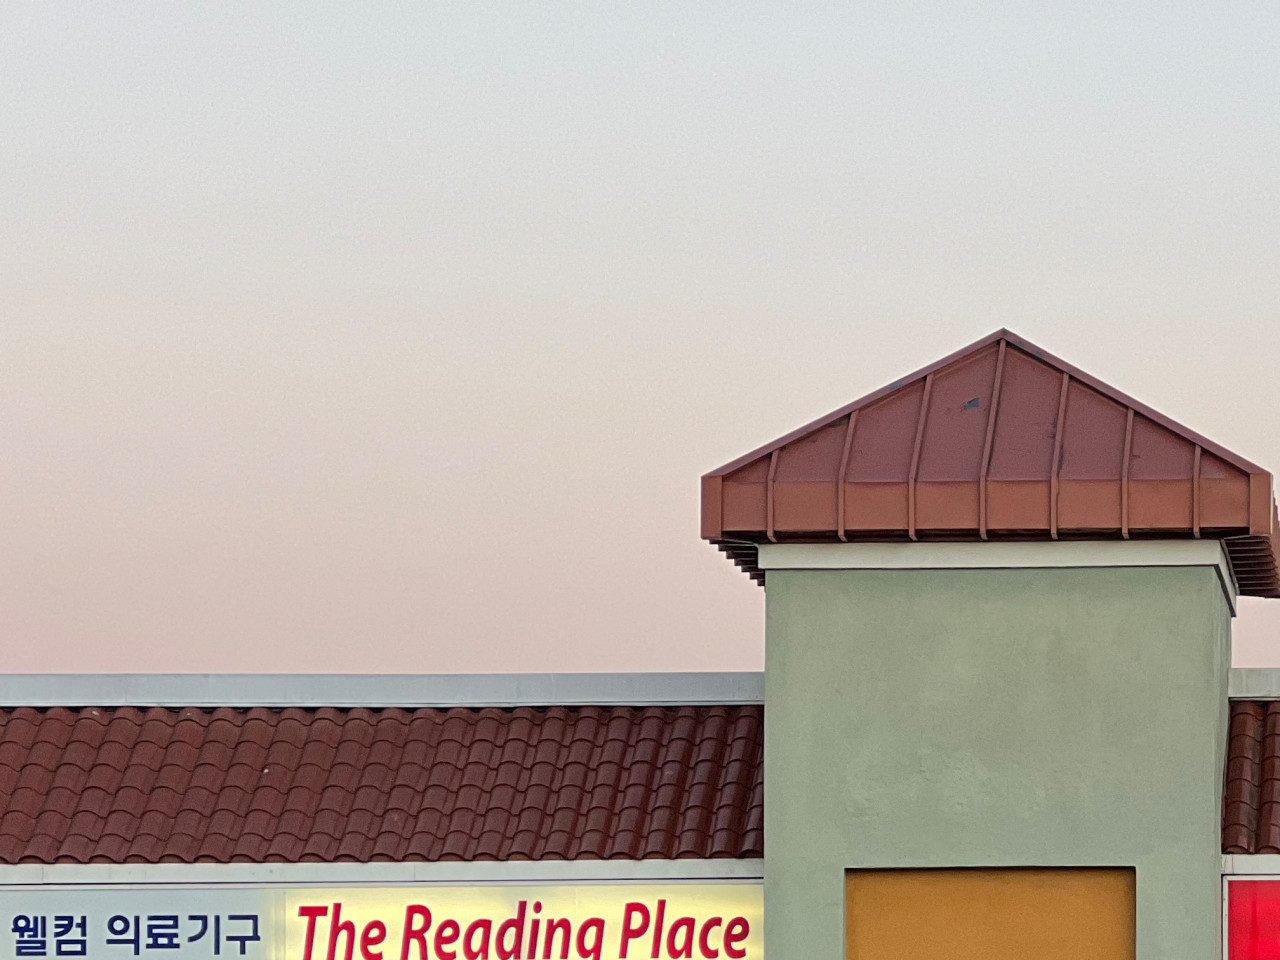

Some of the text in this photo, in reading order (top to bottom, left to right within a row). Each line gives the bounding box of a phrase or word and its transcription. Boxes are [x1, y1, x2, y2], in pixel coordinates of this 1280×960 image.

[12, 914, 260, 956] 웰컴 의료기구
[618, 899, 750, 959] Place
